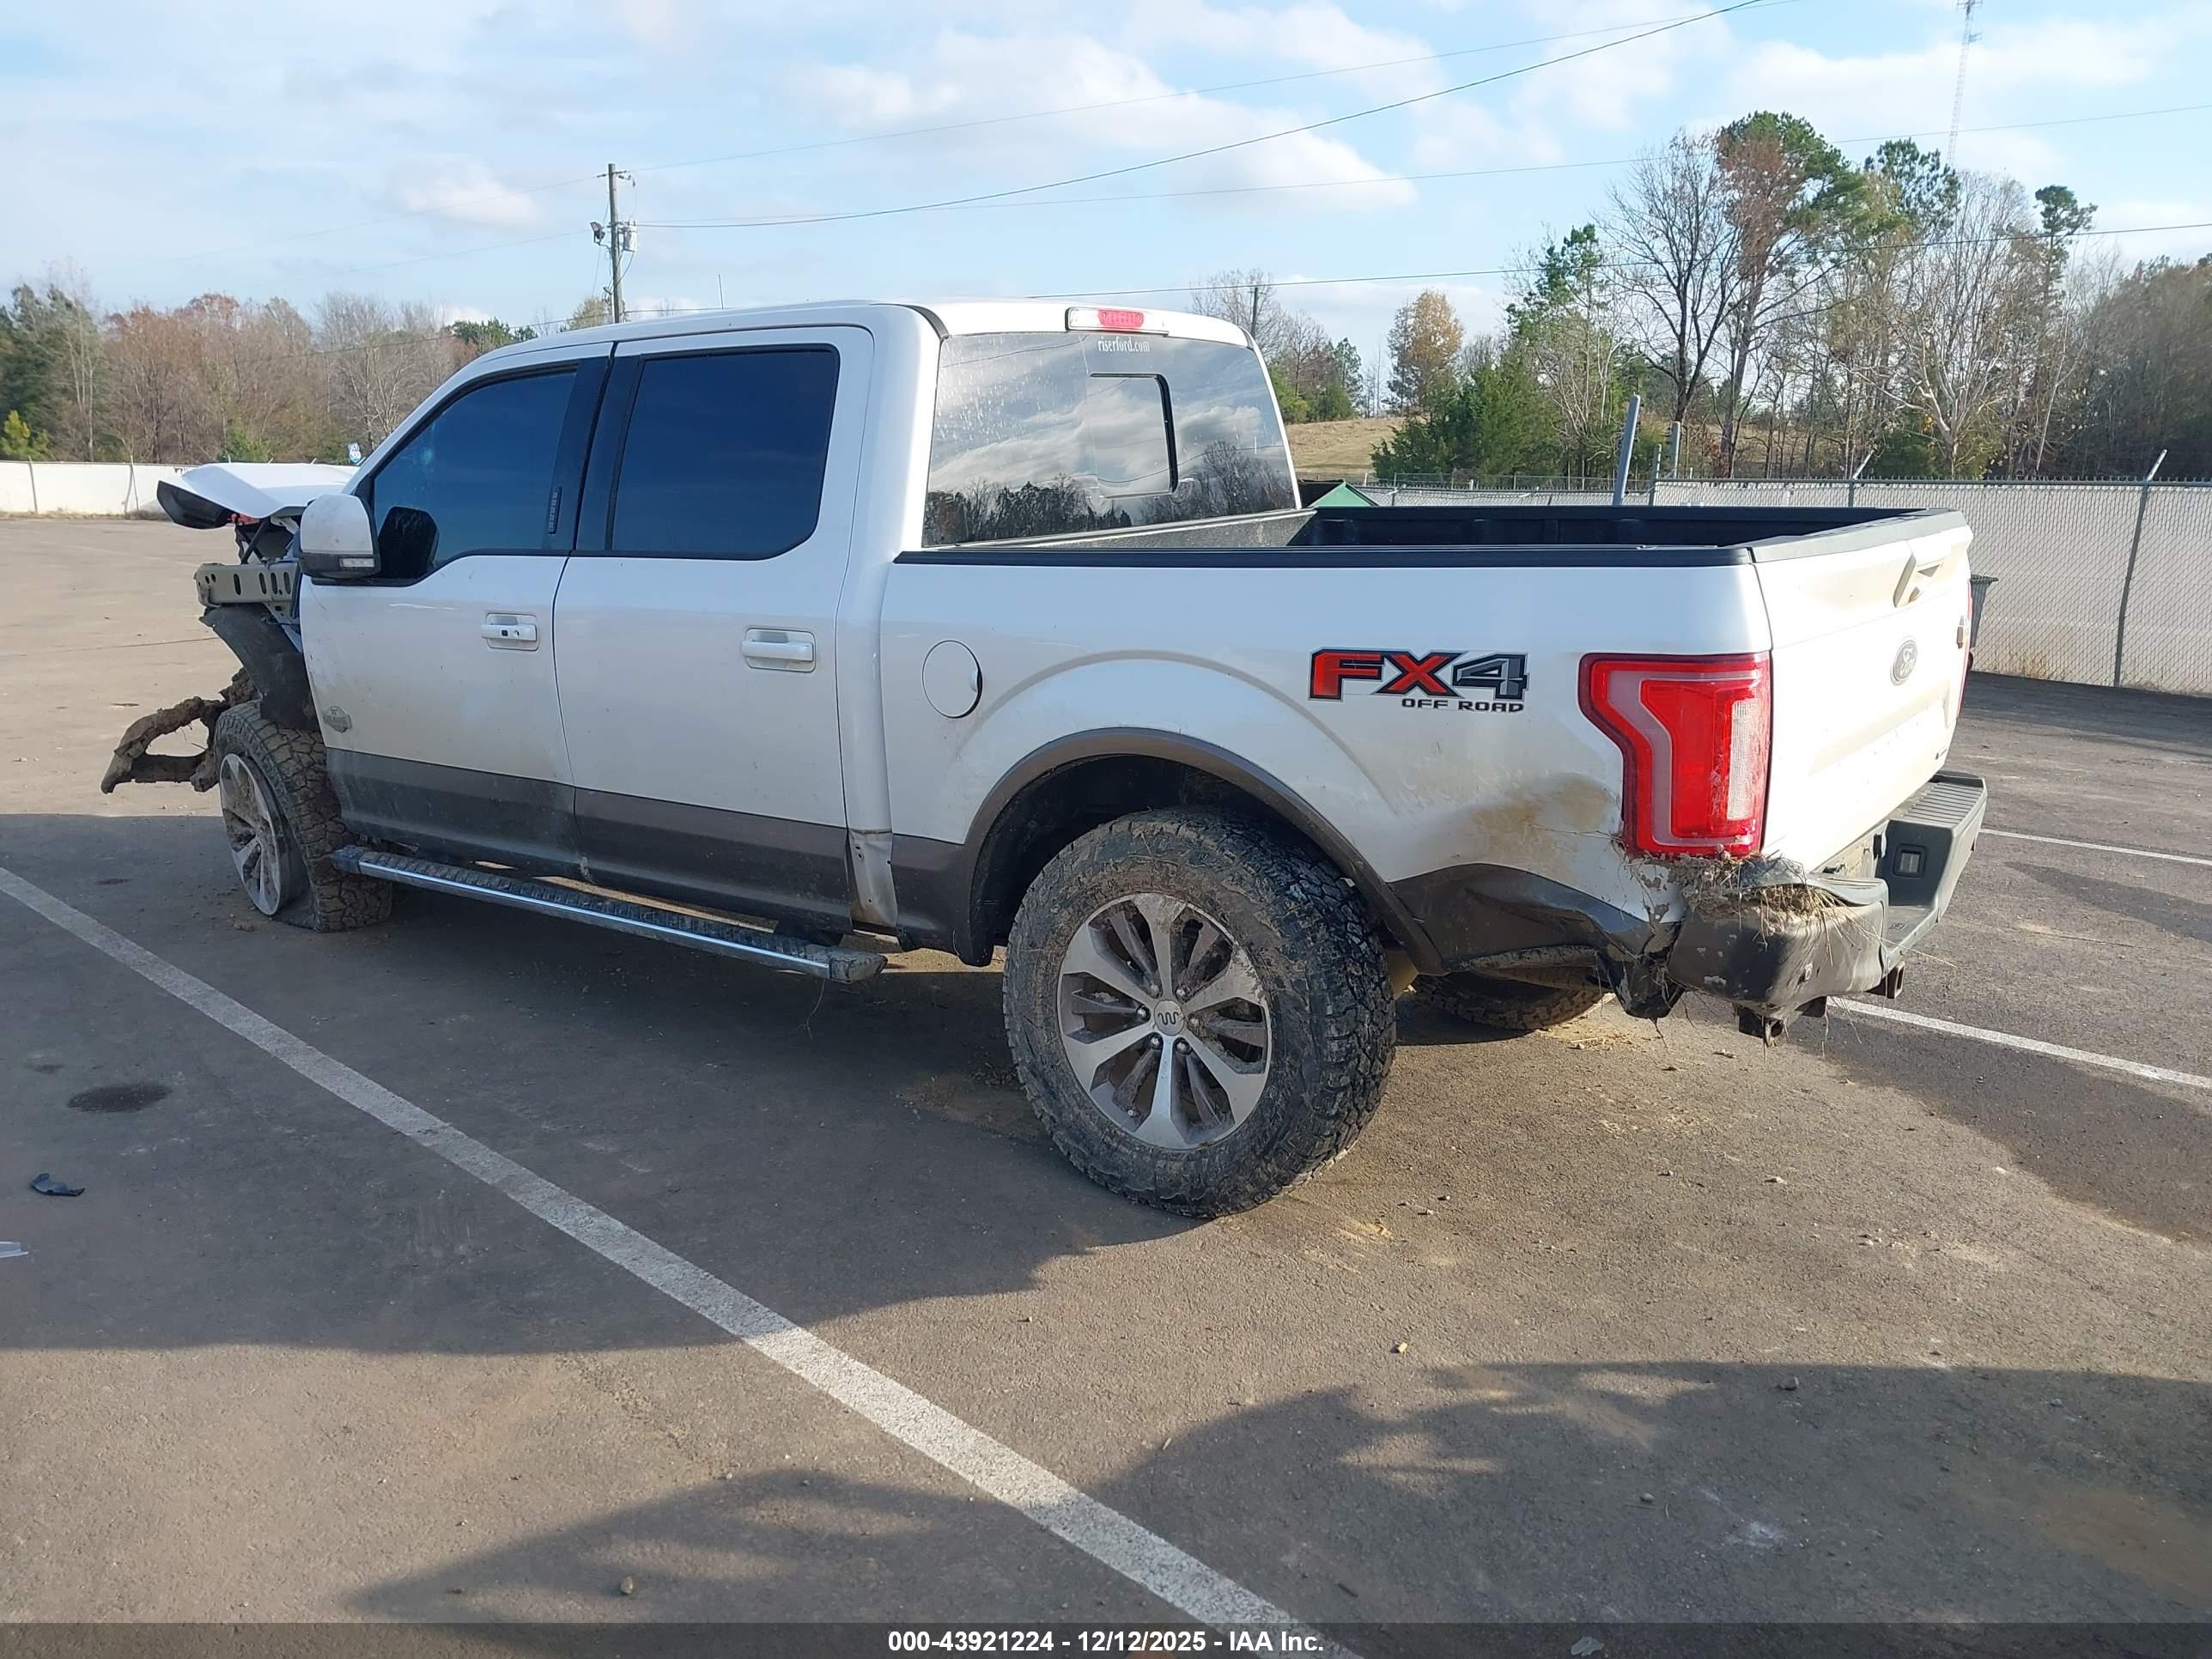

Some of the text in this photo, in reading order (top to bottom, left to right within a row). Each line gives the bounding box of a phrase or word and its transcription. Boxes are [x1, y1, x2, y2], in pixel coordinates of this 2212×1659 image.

[1098, 337, 1150, 352] riserford.com
[1310, 647, 1528, 701] FX4
[1401, 698, 1524, 713] OFF ROAD
